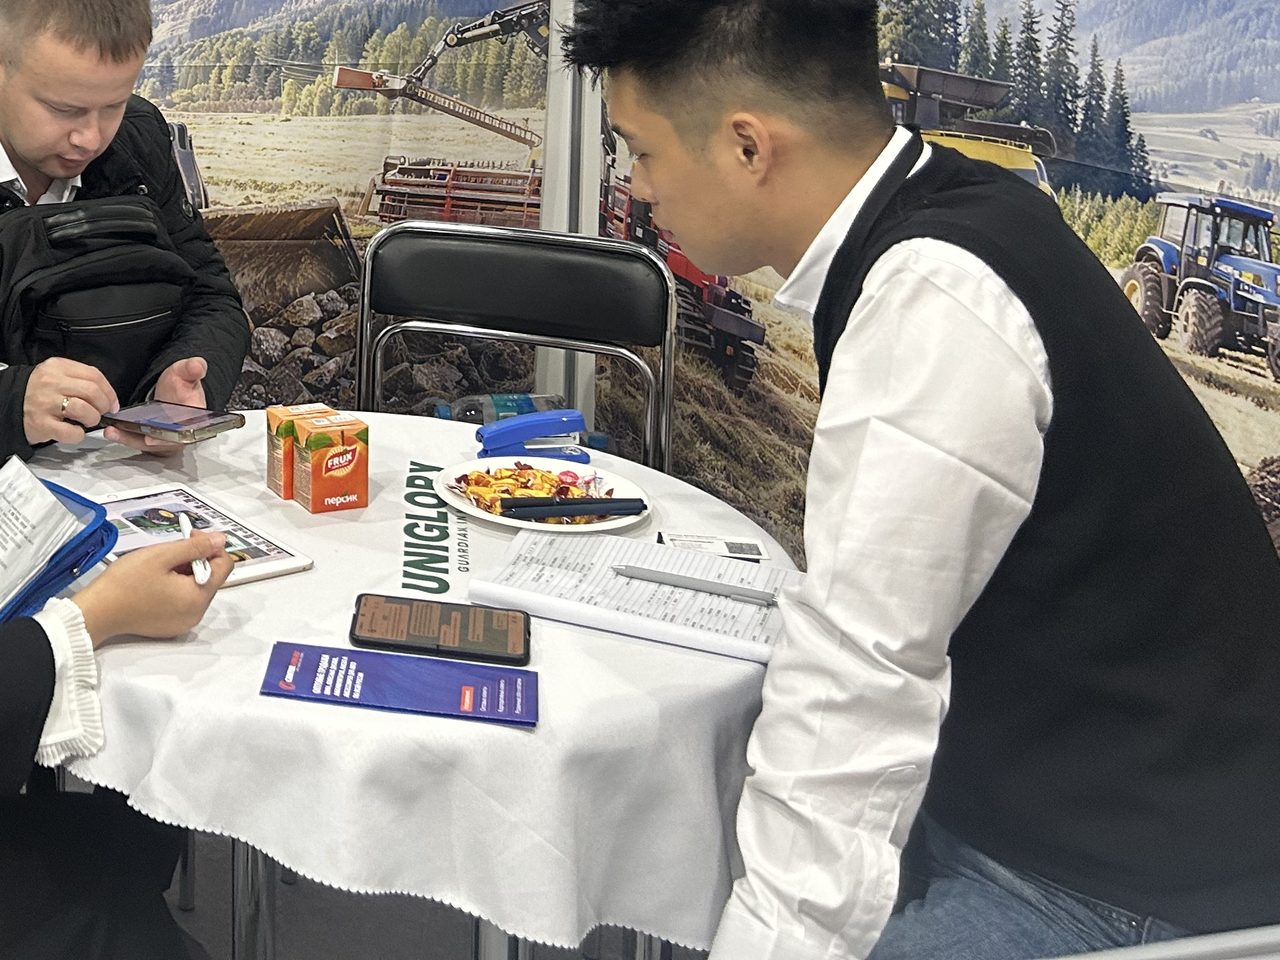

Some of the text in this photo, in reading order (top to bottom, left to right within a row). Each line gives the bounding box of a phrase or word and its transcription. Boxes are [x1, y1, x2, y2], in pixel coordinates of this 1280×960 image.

[327, 451, 353, 469] FRUX
[324, 493, 358, 507] персик
[402, 461, 450, 594] UNIGLORY
